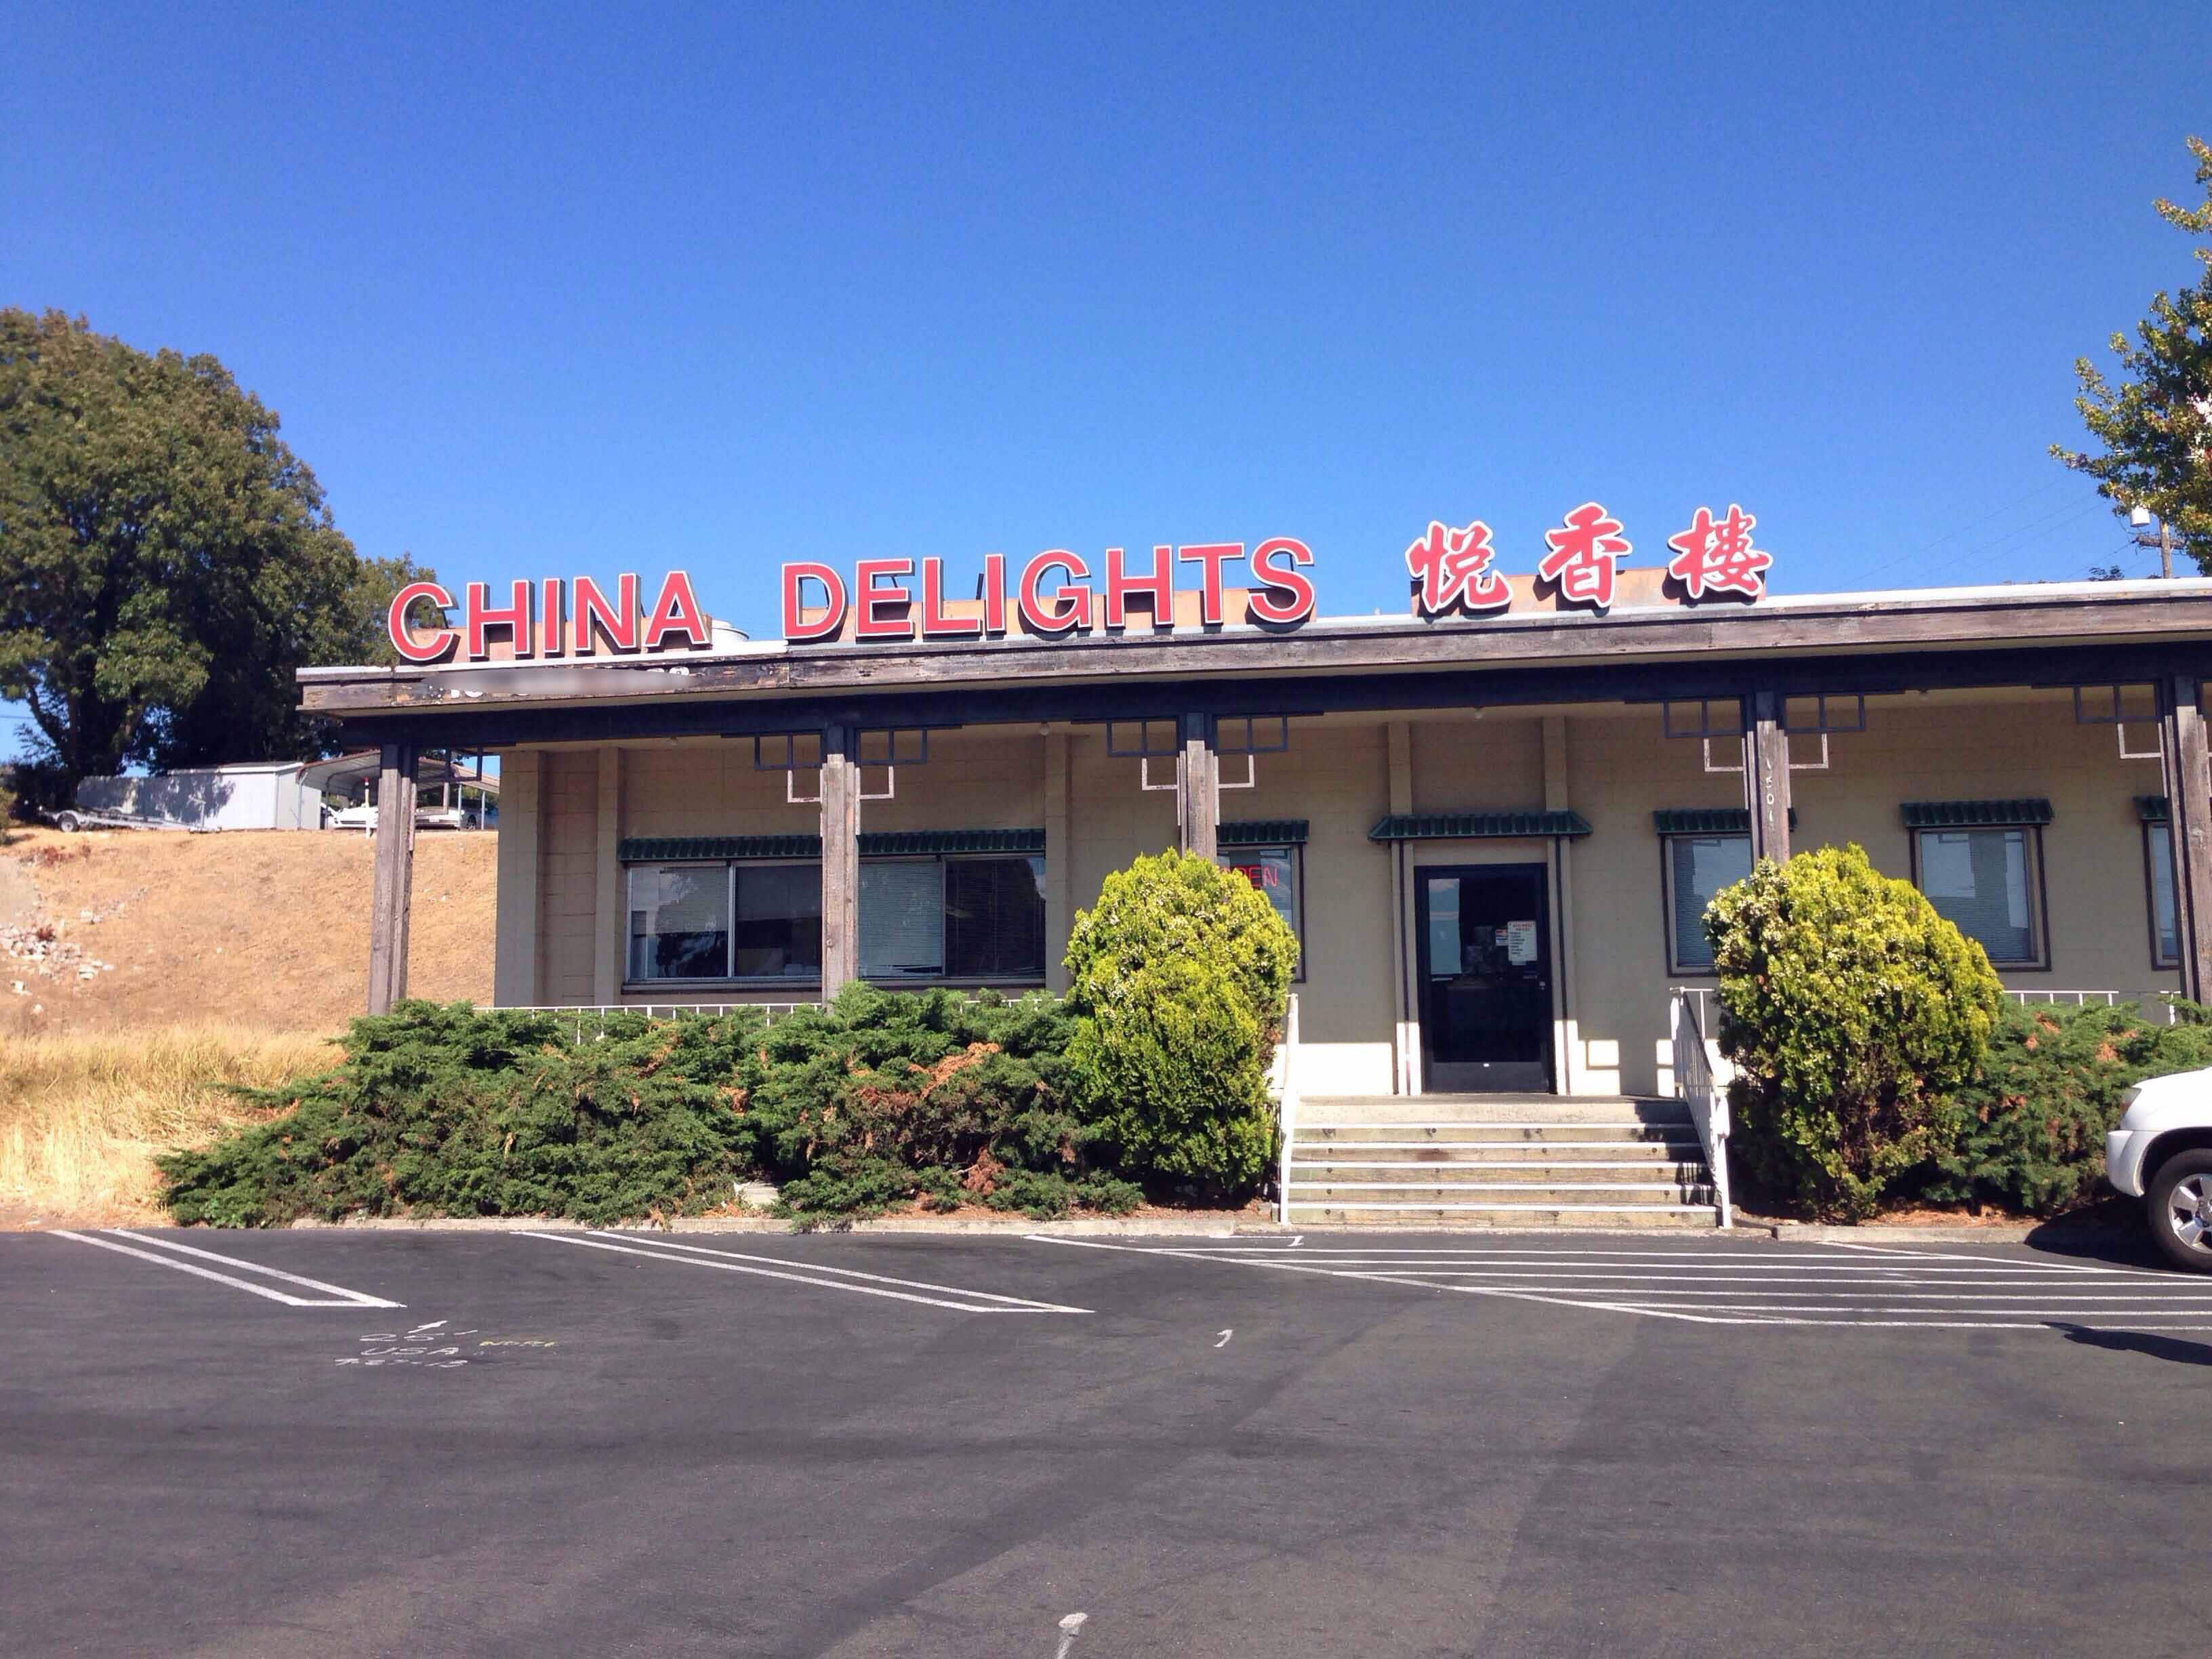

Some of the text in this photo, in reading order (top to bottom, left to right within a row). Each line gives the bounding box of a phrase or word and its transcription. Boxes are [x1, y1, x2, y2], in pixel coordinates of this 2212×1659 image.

[388, 537, 1315, 661] CHINA DELIGHTS
[1218, 866, 1279, 887] EN
[360, 1346, 459, 1355] USA
